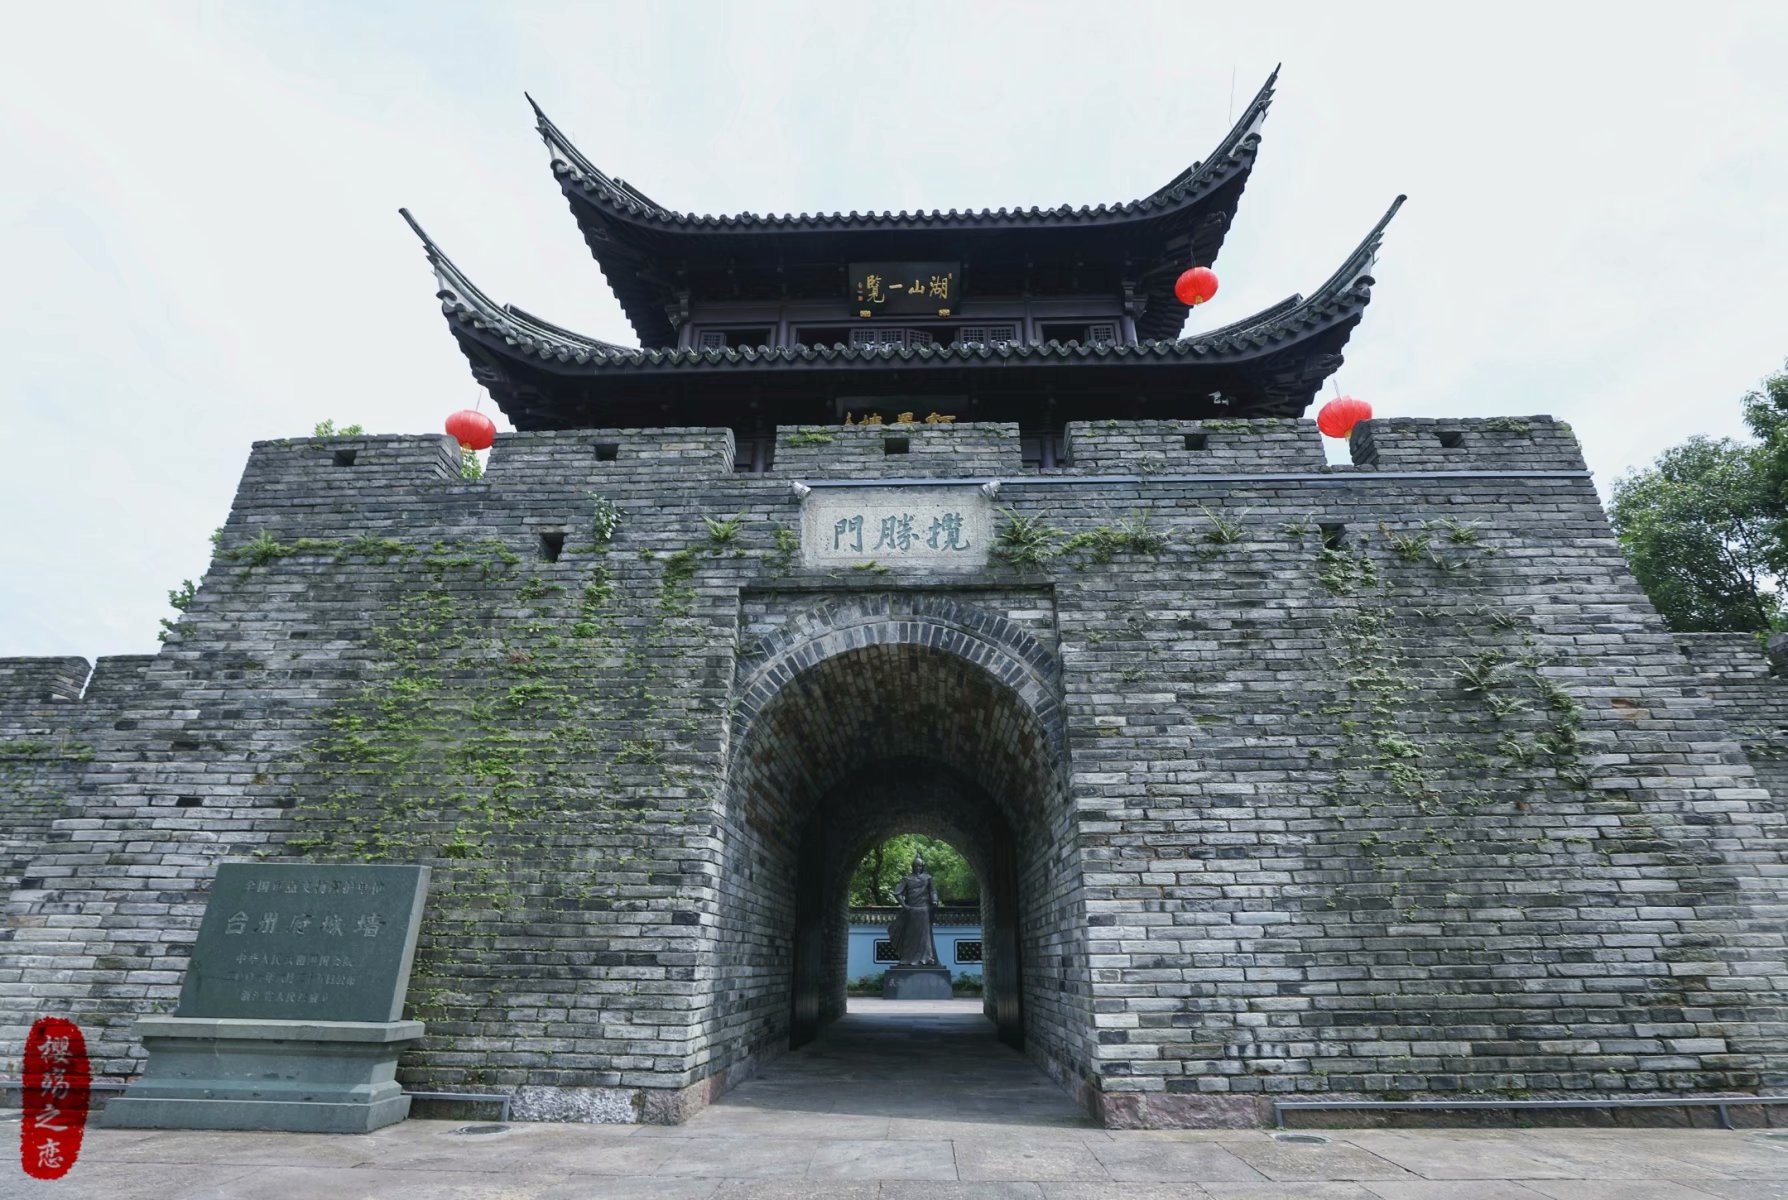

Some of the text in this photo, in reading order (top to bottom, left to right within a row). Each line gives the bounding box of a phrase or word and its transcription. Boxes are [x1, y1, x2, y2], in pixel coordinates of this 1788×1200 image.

[225, 911, 386, 938] 台州府城墙
